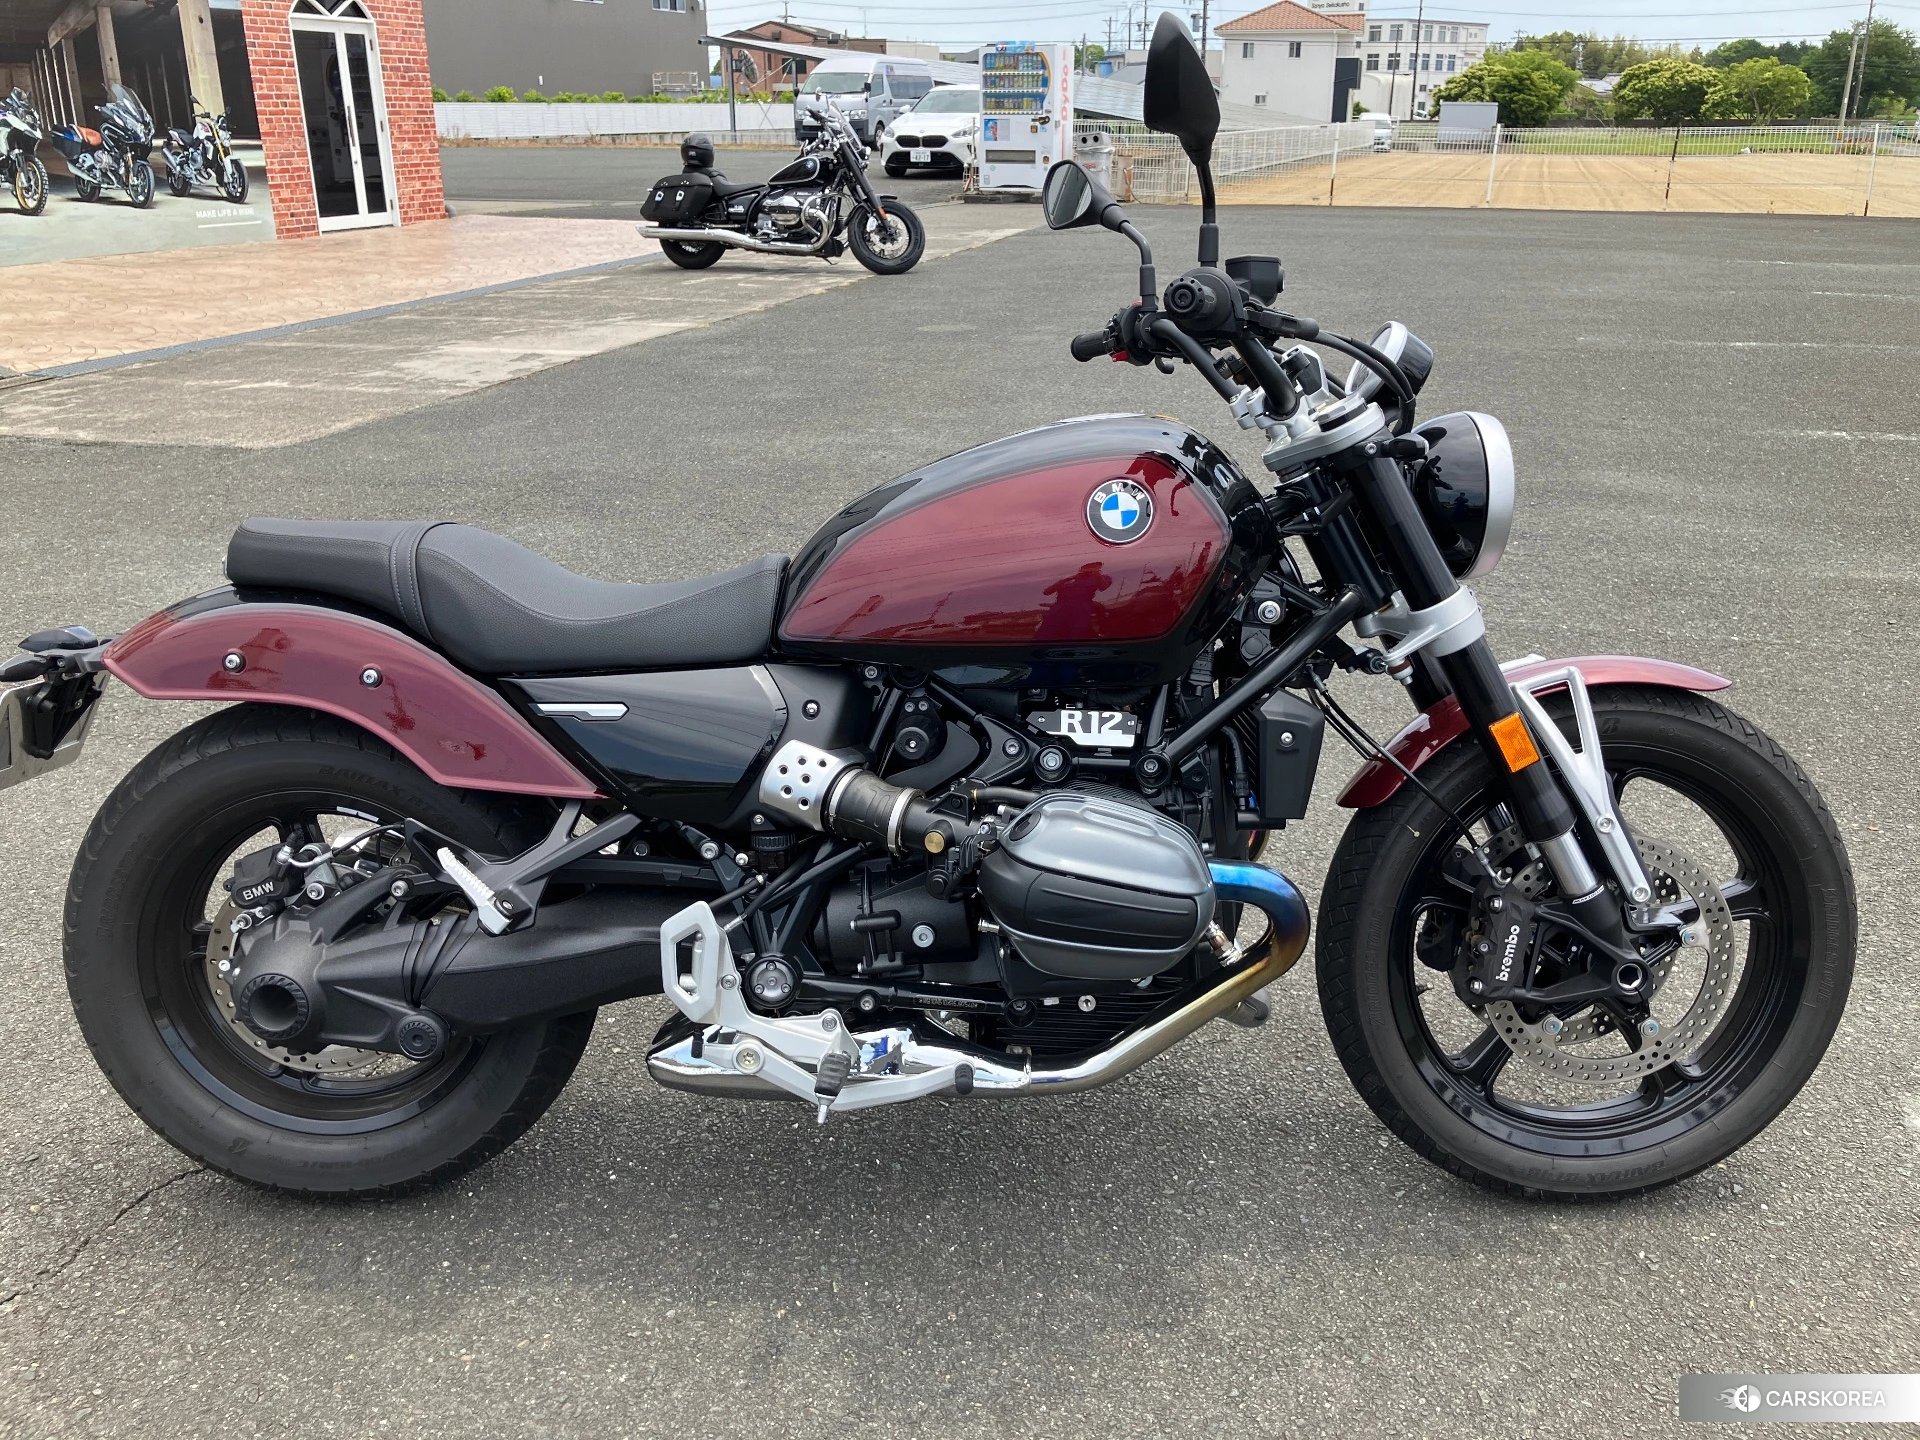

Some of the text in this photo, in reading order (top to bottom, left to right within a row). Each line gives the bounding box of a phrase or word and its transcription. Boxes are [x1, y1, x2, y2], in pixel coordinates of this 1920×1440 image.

[1061, 64, 1070, 121] DyDo
[196, 209, 217, 218] MAKE
[217, 208, 231, 217] LIFE
[1093, 482, 1146, 504] BMW
[242, 881, 274, 900] BMW
[1495, 924, 1520, 982] brembo
